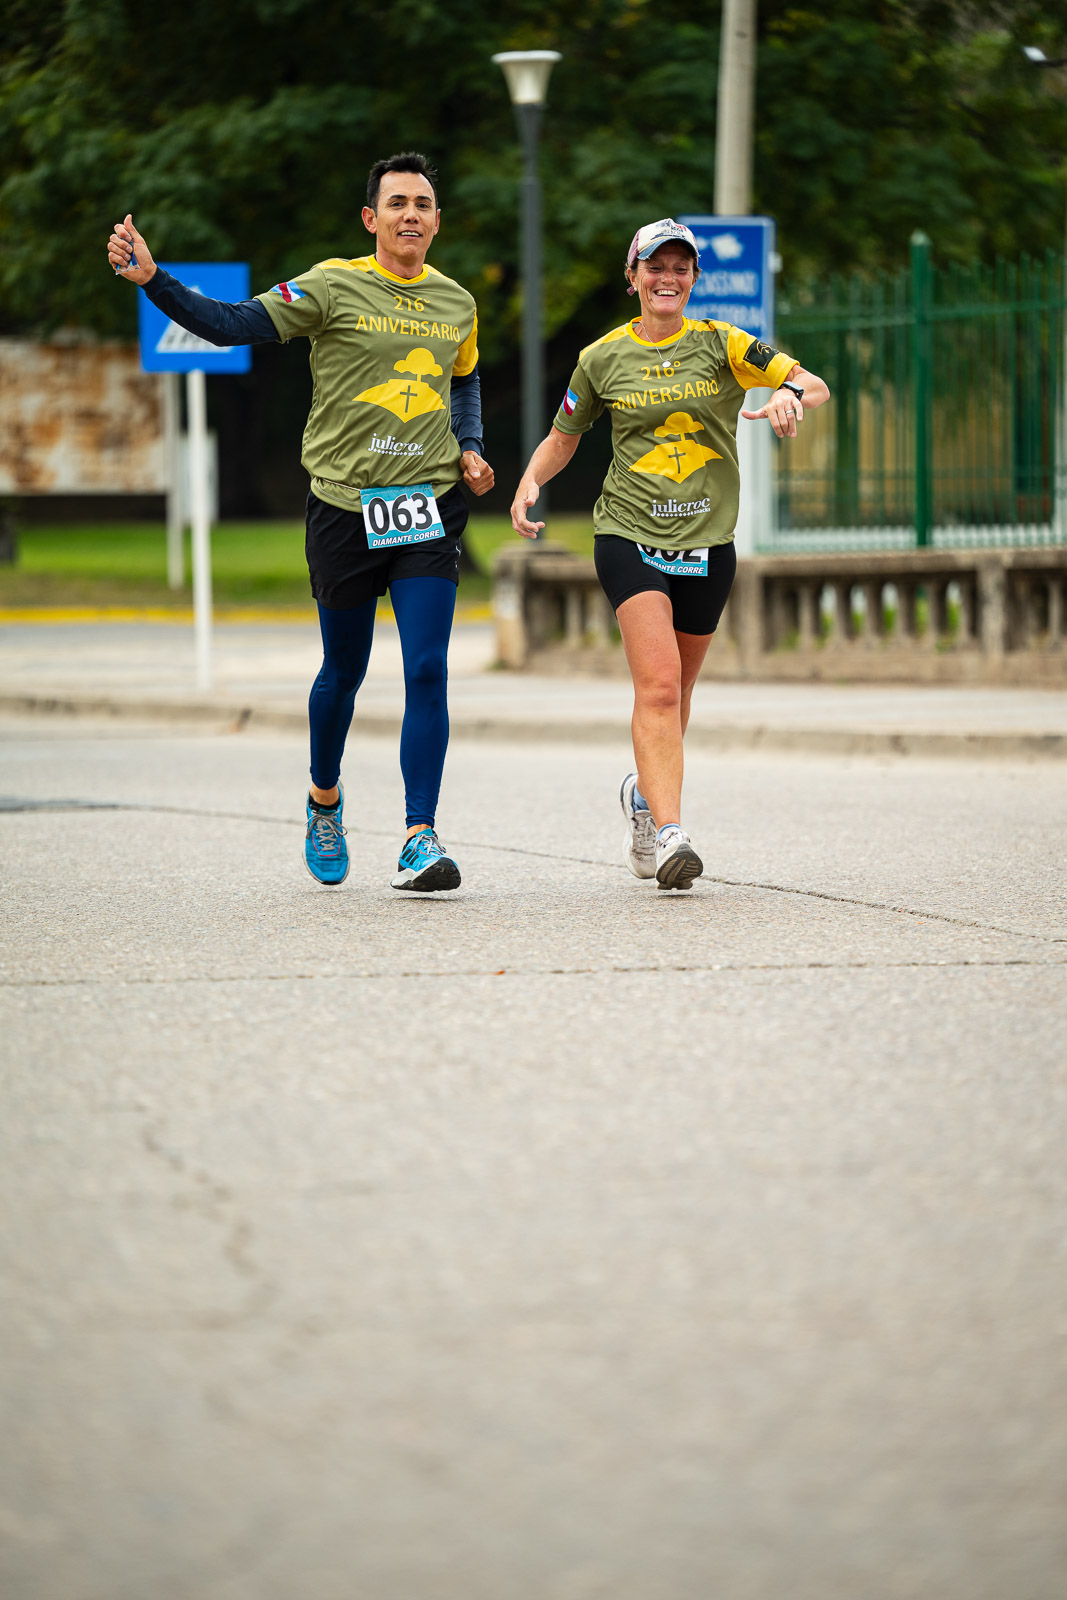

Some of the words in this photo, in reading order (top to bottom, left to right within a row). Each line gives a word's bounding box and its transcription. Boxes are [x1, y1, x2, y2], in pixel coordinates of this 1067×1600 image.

[355, 315, 460, 342] ANIVERSARIO
[368, 492, 433, 536] 063
[650, 497, 710, 516] julicroc
[372, 534, 413, 547] DIAMANTE
[414, 529, 441, 541] CORRE
[645, 557, 677, 573] DIAMANTE
[677, 566, 704, 574] CORRE
